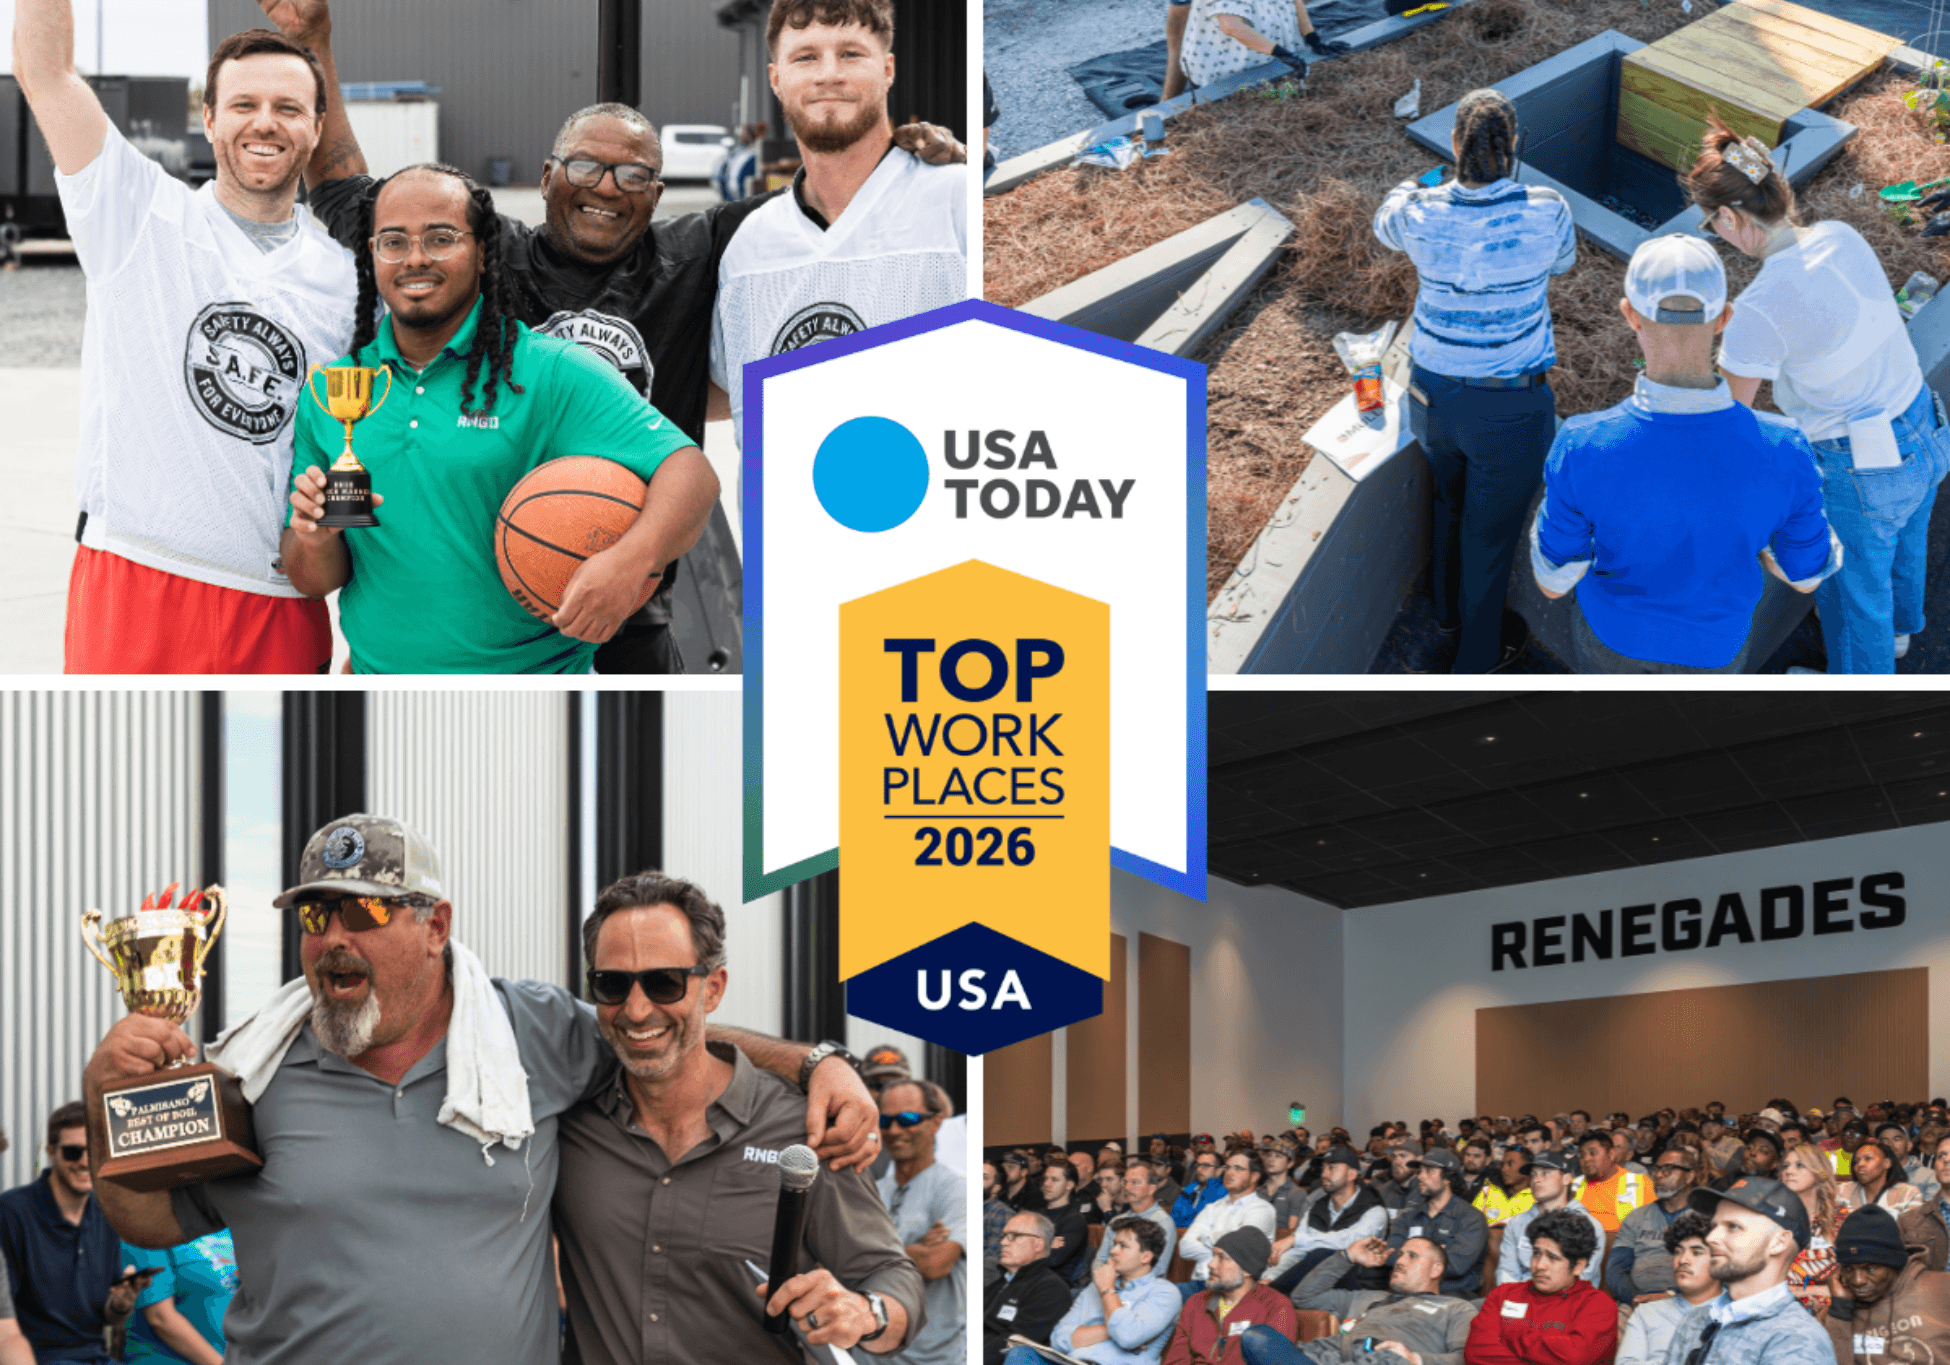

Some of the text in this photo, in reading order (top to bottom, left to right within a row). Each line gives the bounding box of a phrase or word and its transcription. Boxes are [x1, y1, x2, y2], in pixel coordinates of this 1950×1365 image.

[204, 315, 296, 371] SAFETY ALWAYS
[580, 322, 634, 360] ALWAYS
[198, 377, 223, 409] FOR
[1491, 871, 1907, 972] RENEGADES
[127, 1115, 154, 1128] BEST
[156, 1112, 170, 1122] OF
[131, 1098, 190, 1116] PALMISANO
[118, 1117, 209, 1147] CHAMPION
